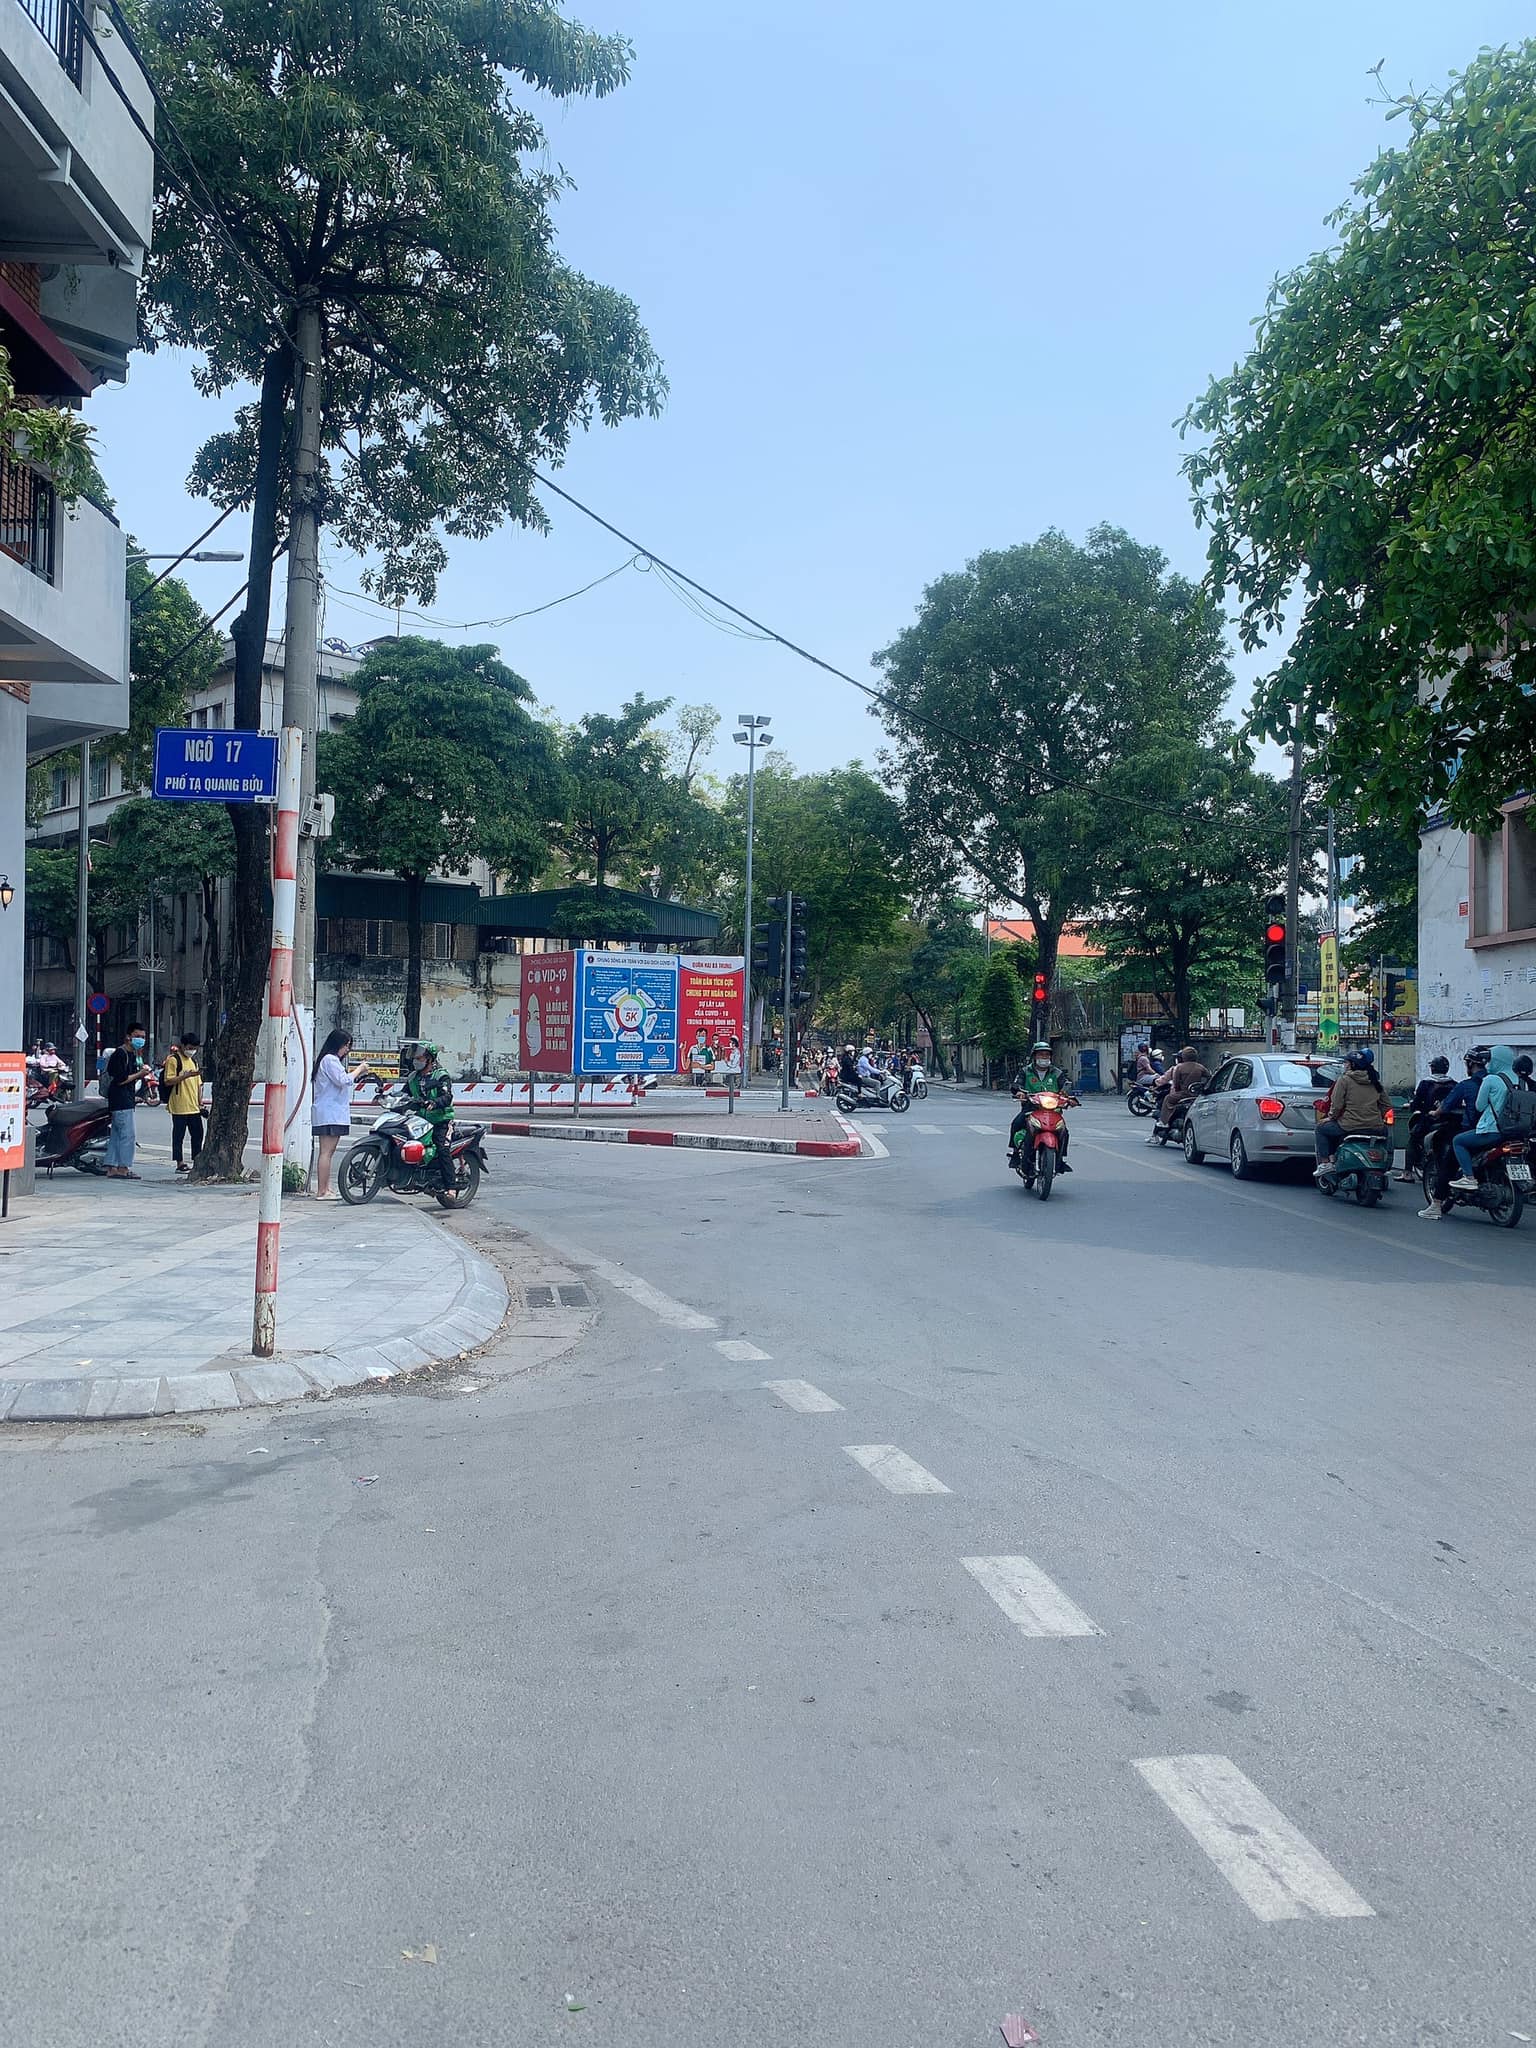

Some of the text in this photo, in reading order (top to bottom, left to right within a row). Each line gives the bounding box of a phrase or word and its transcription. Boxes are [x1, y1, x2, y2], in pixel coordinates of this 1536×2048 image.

[185, 735, 242, 763] NGÕ 17
[165, 772, 264, 794] PHỐ TẠ QUANG BỬU
[527, 968, 567, 984] COVID-19
[625, 1011, 638, 1022] 5K
